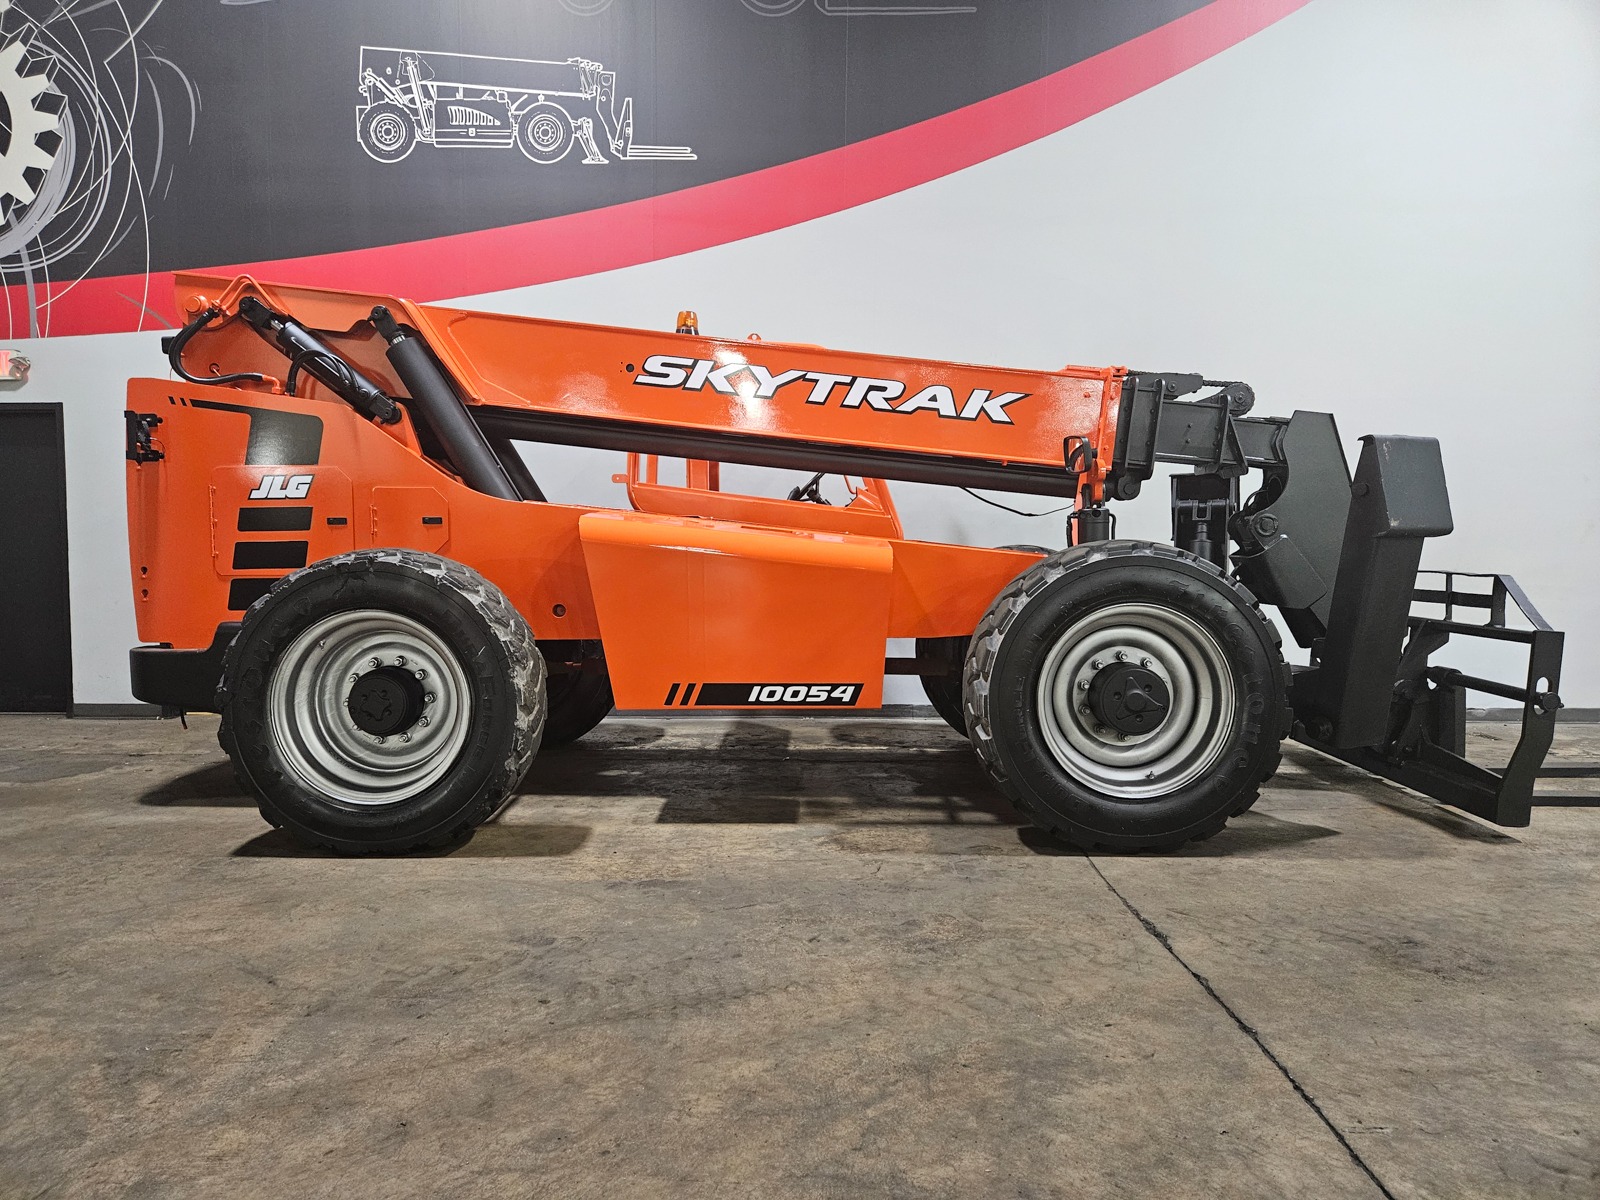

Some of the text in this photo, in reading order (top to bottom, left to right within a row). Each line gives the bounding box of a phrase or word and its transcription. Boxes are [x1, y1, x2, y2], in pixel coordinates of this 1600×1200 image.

[633, 354, 1033, 425] SKYTRAK
[248, 475, 314, 500] JLG
[748, 685, 856, 702] 10054
